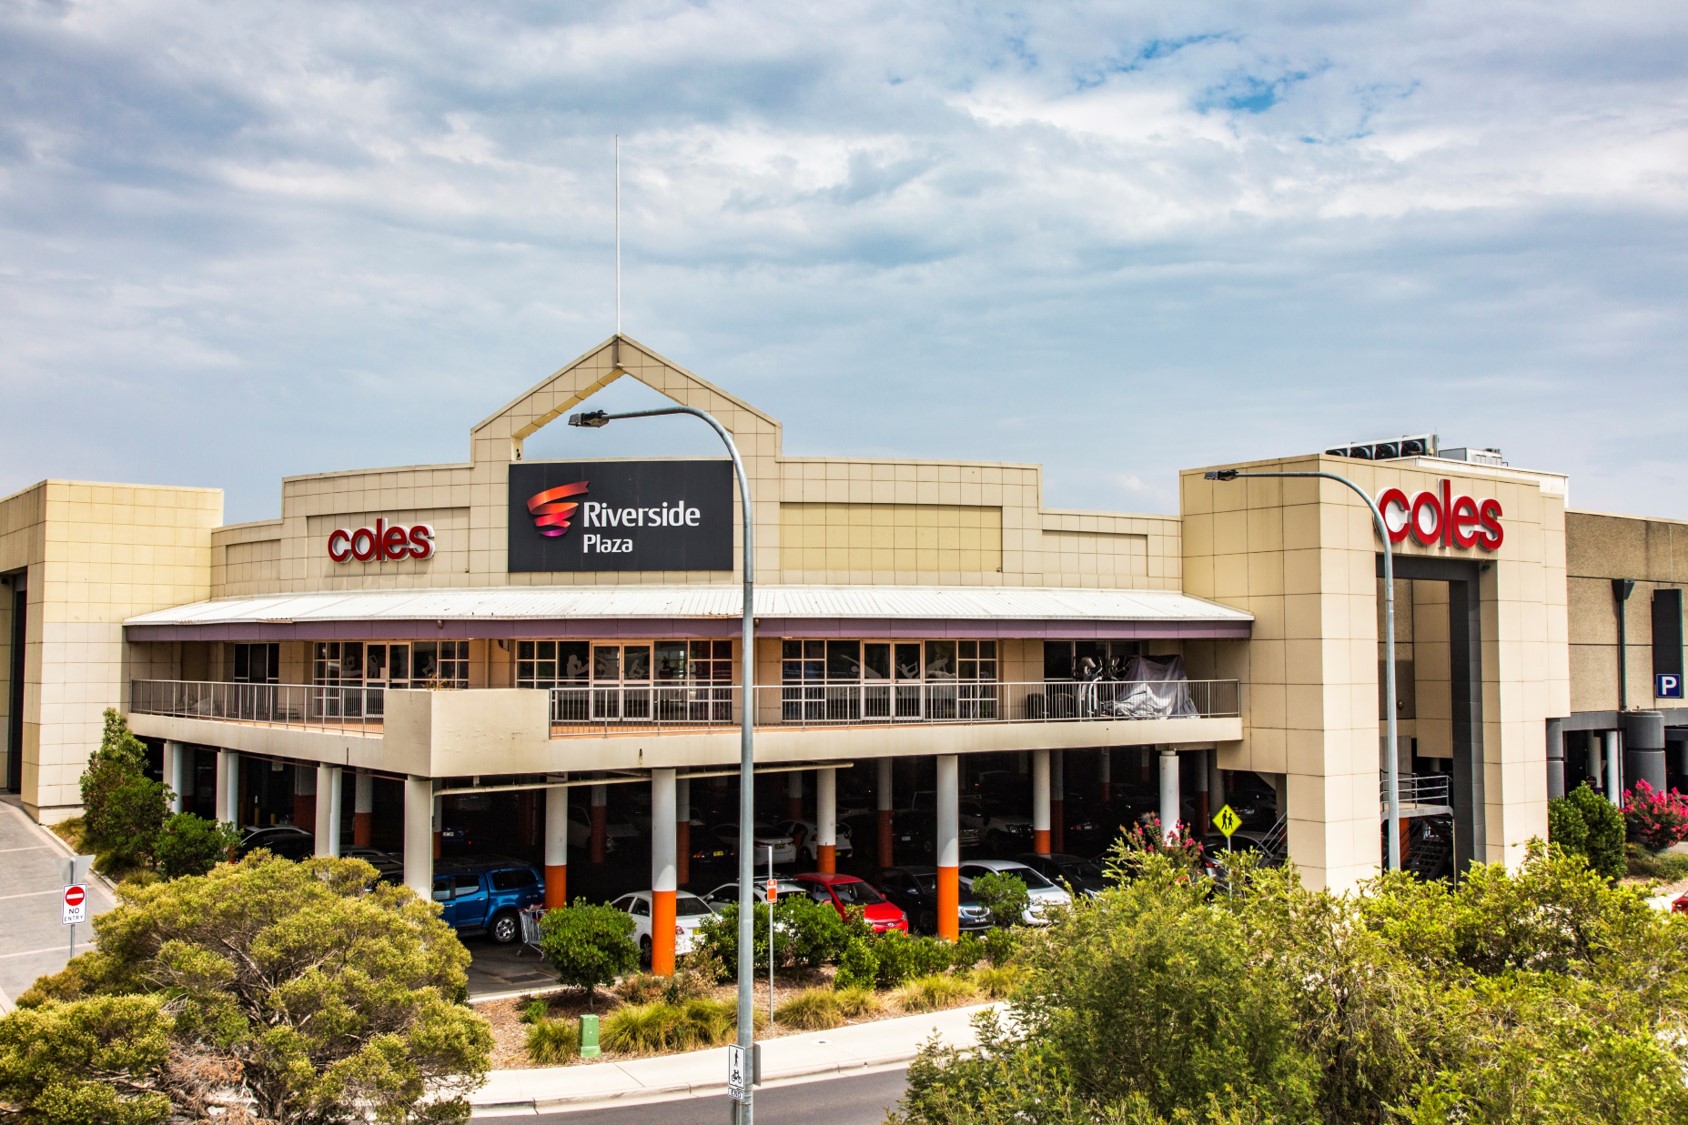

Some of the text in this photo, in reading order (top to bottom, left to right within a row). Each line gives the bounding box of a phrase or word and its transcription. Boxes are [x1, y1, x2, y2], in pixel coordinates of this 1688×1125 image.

[583, 500, 701, 527] Riverside
[1376, 479, 1504, 551] coles
[328, 518, 434, 562] coles
[583, 534, 634, 553] Plaza
[1661, 676, 1677, 695] P
